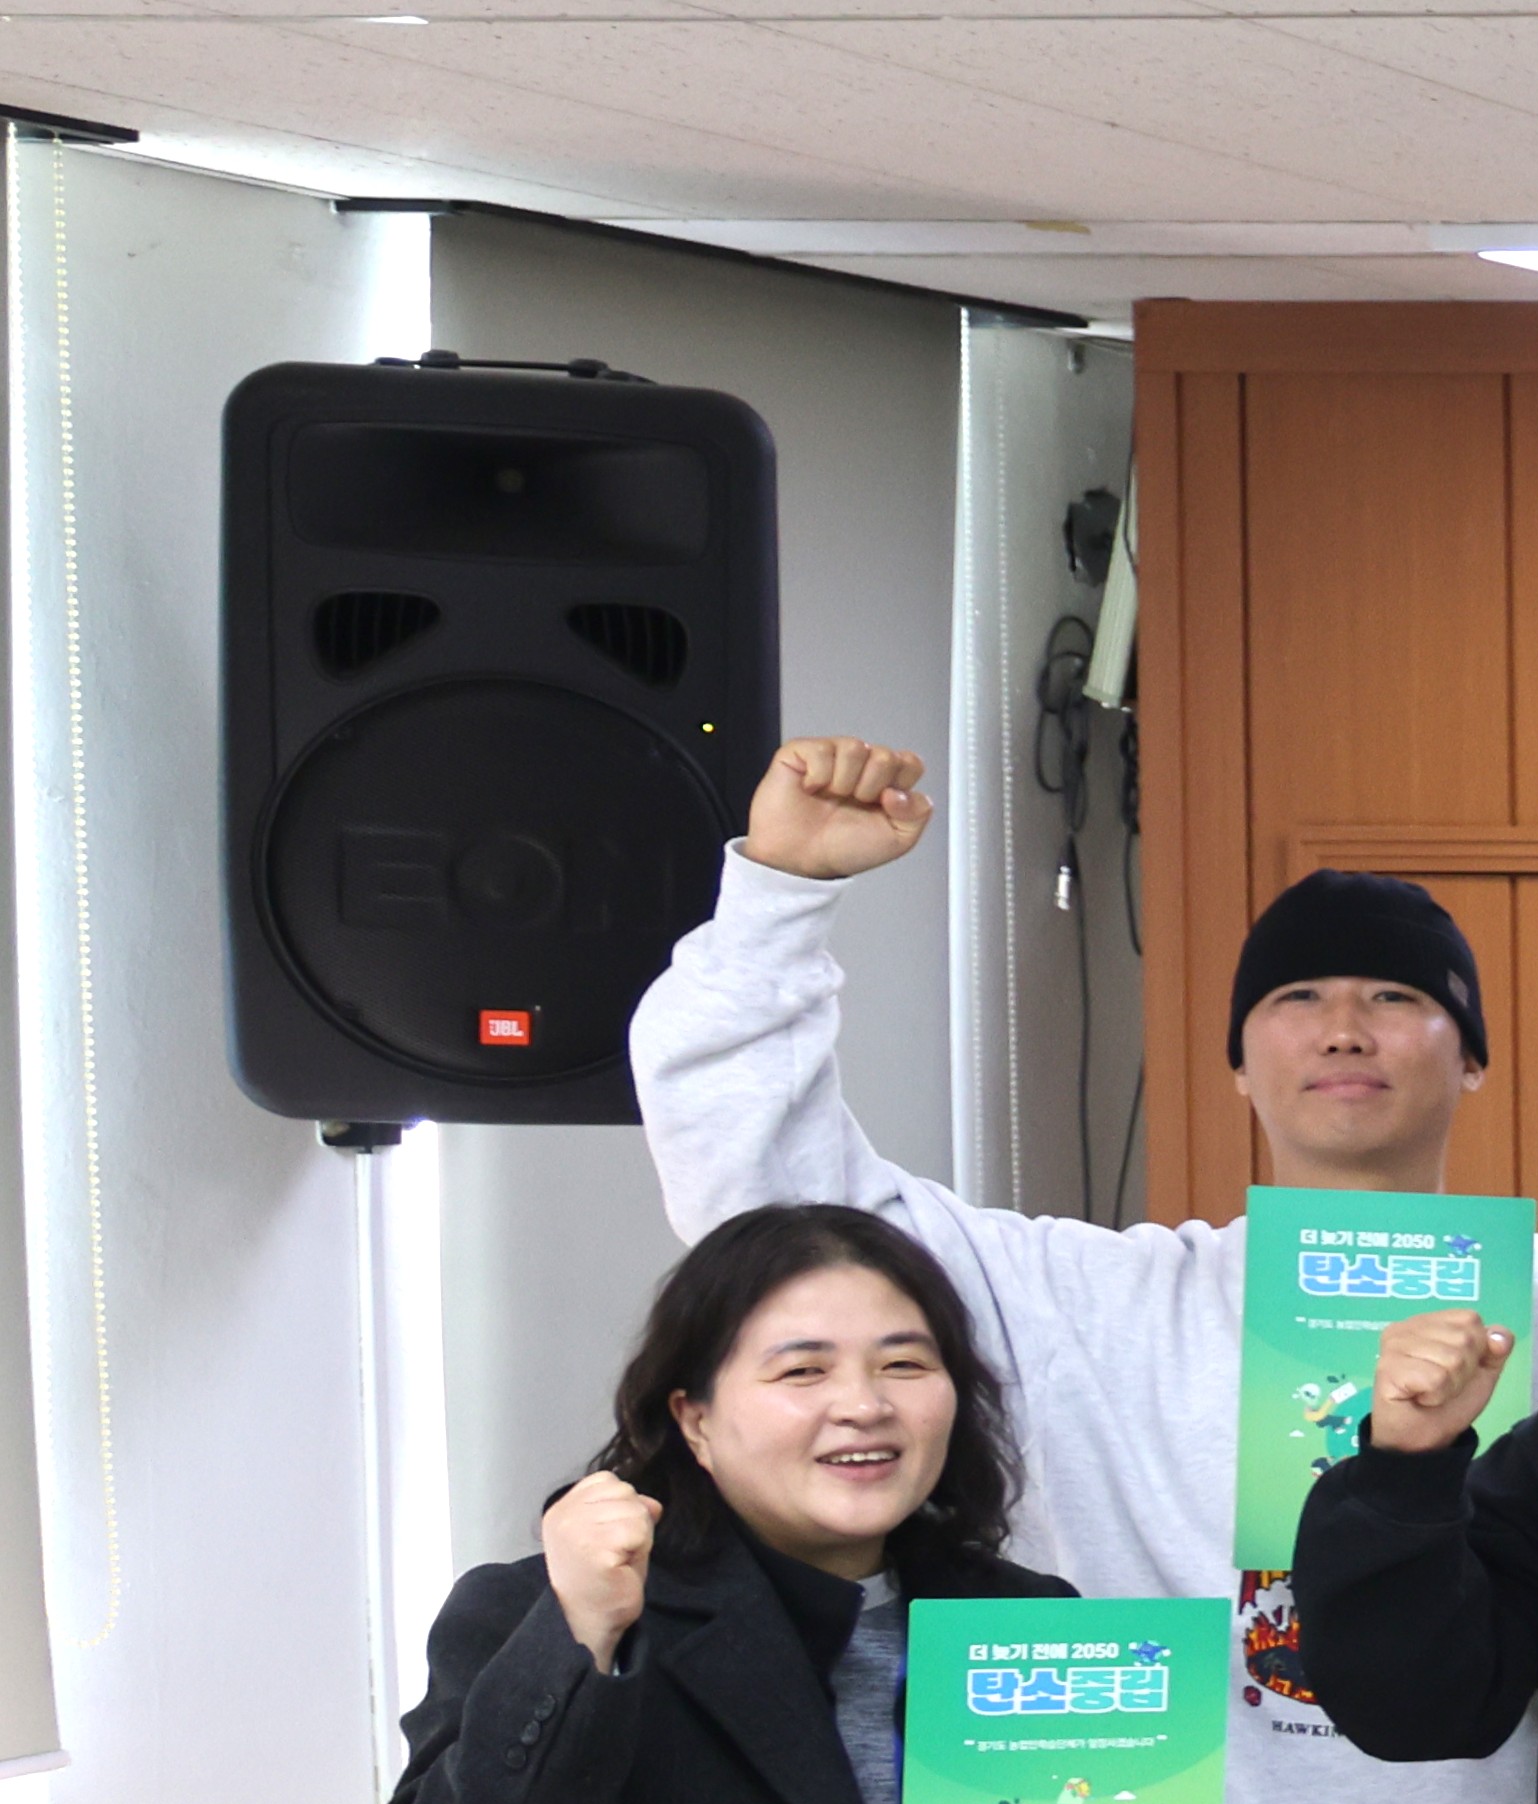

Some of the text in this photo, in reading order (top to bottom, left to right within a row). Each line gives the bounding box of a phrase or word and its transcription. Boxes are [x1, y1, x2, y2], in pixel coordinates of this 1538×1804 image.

[489, 1019, 524, 1037] JBL
[1391, 1232, 1434, 1249] 2050
[1298, 1251, 1478, 1300] 탄소중립
[968, 1643, 987, 1661] 더
[1071, 1642, 1119, 1659] 2050
[966, 1665, 1168, 1716] 탄소중립
